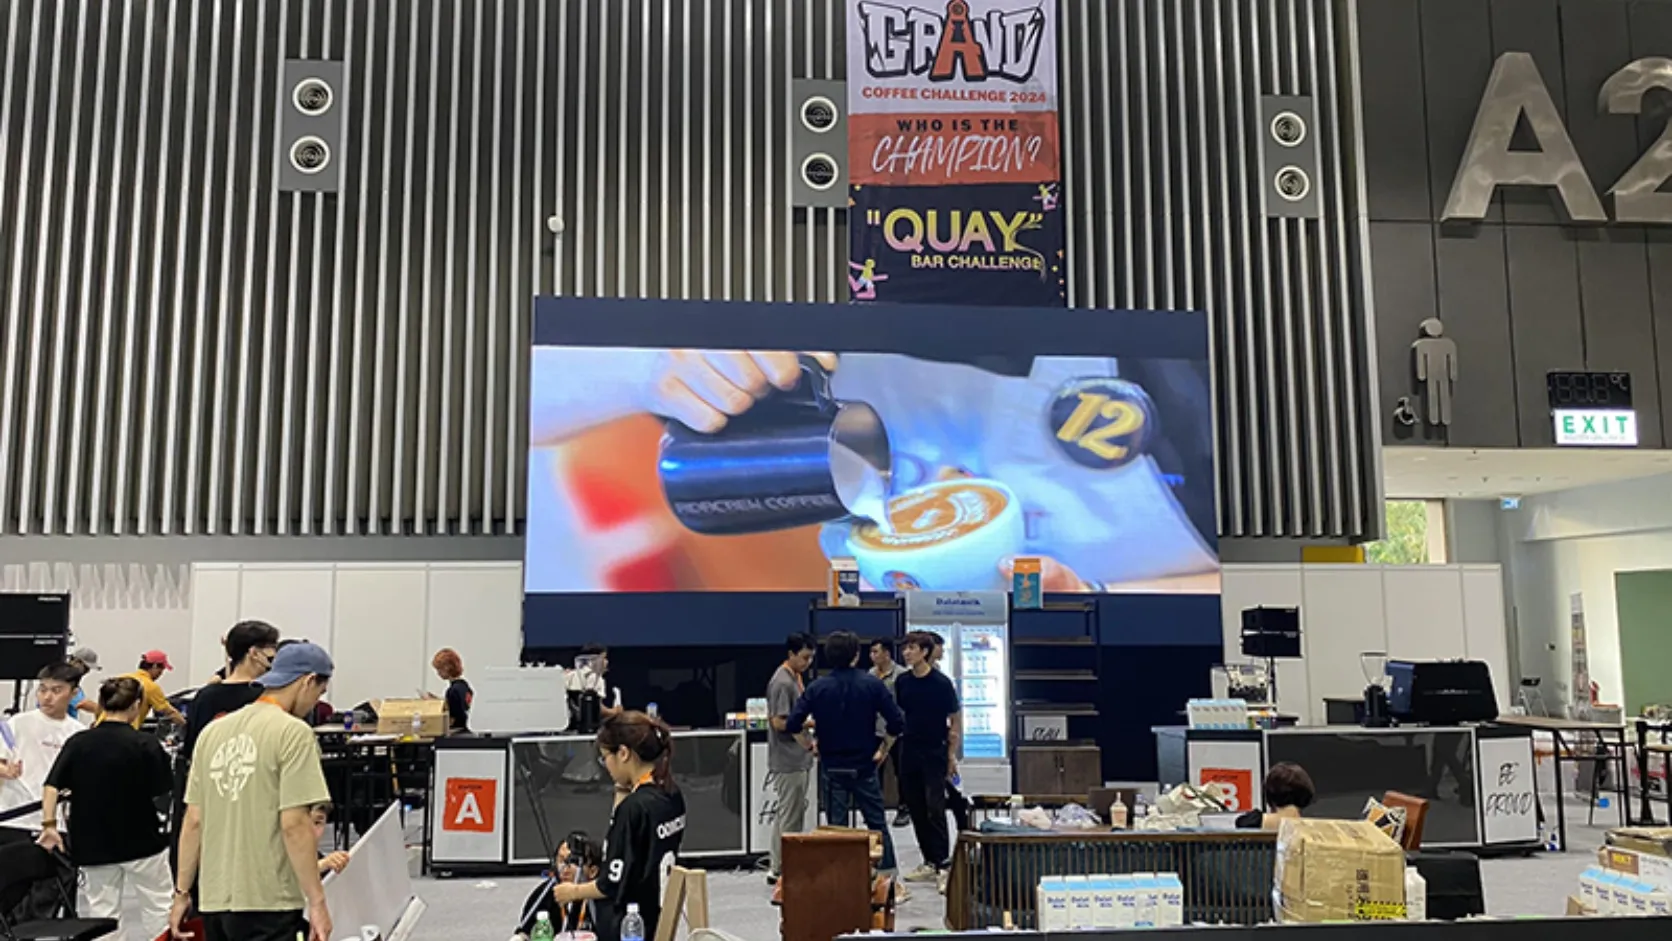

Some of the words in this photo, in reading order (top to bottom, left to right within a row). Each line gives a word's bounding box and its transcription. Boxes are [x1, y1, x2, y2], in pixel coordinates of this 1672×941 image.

[859, 0, 1045, 83] GRAND
[862, 86, 917, 99] COFFEE
[921, 88, 1006, 102] CHALLENGE
[1009, 91, 1046, 103] 2024
[897, 119, 943, 132] WHO
[952, 119, 972, 131] IS
[980, 119, 1018, 131] THE
[1441, 52, 1672, 221] A2
[872, 135, 1042, 178] CHAMPION?
[911, 254, 944, 268] BAR
[948, 255, 1043, 270] CHALLENGE
[1056, 392, 1145, 461] 12
[1562, 415, 1628, 434] EXIT
[1498, 762, 1519, 787] BE
[454, 791, 484, 825] A
[1486, 791, 1532, 816] PROUD
[607, 858, 624, 882] 9
